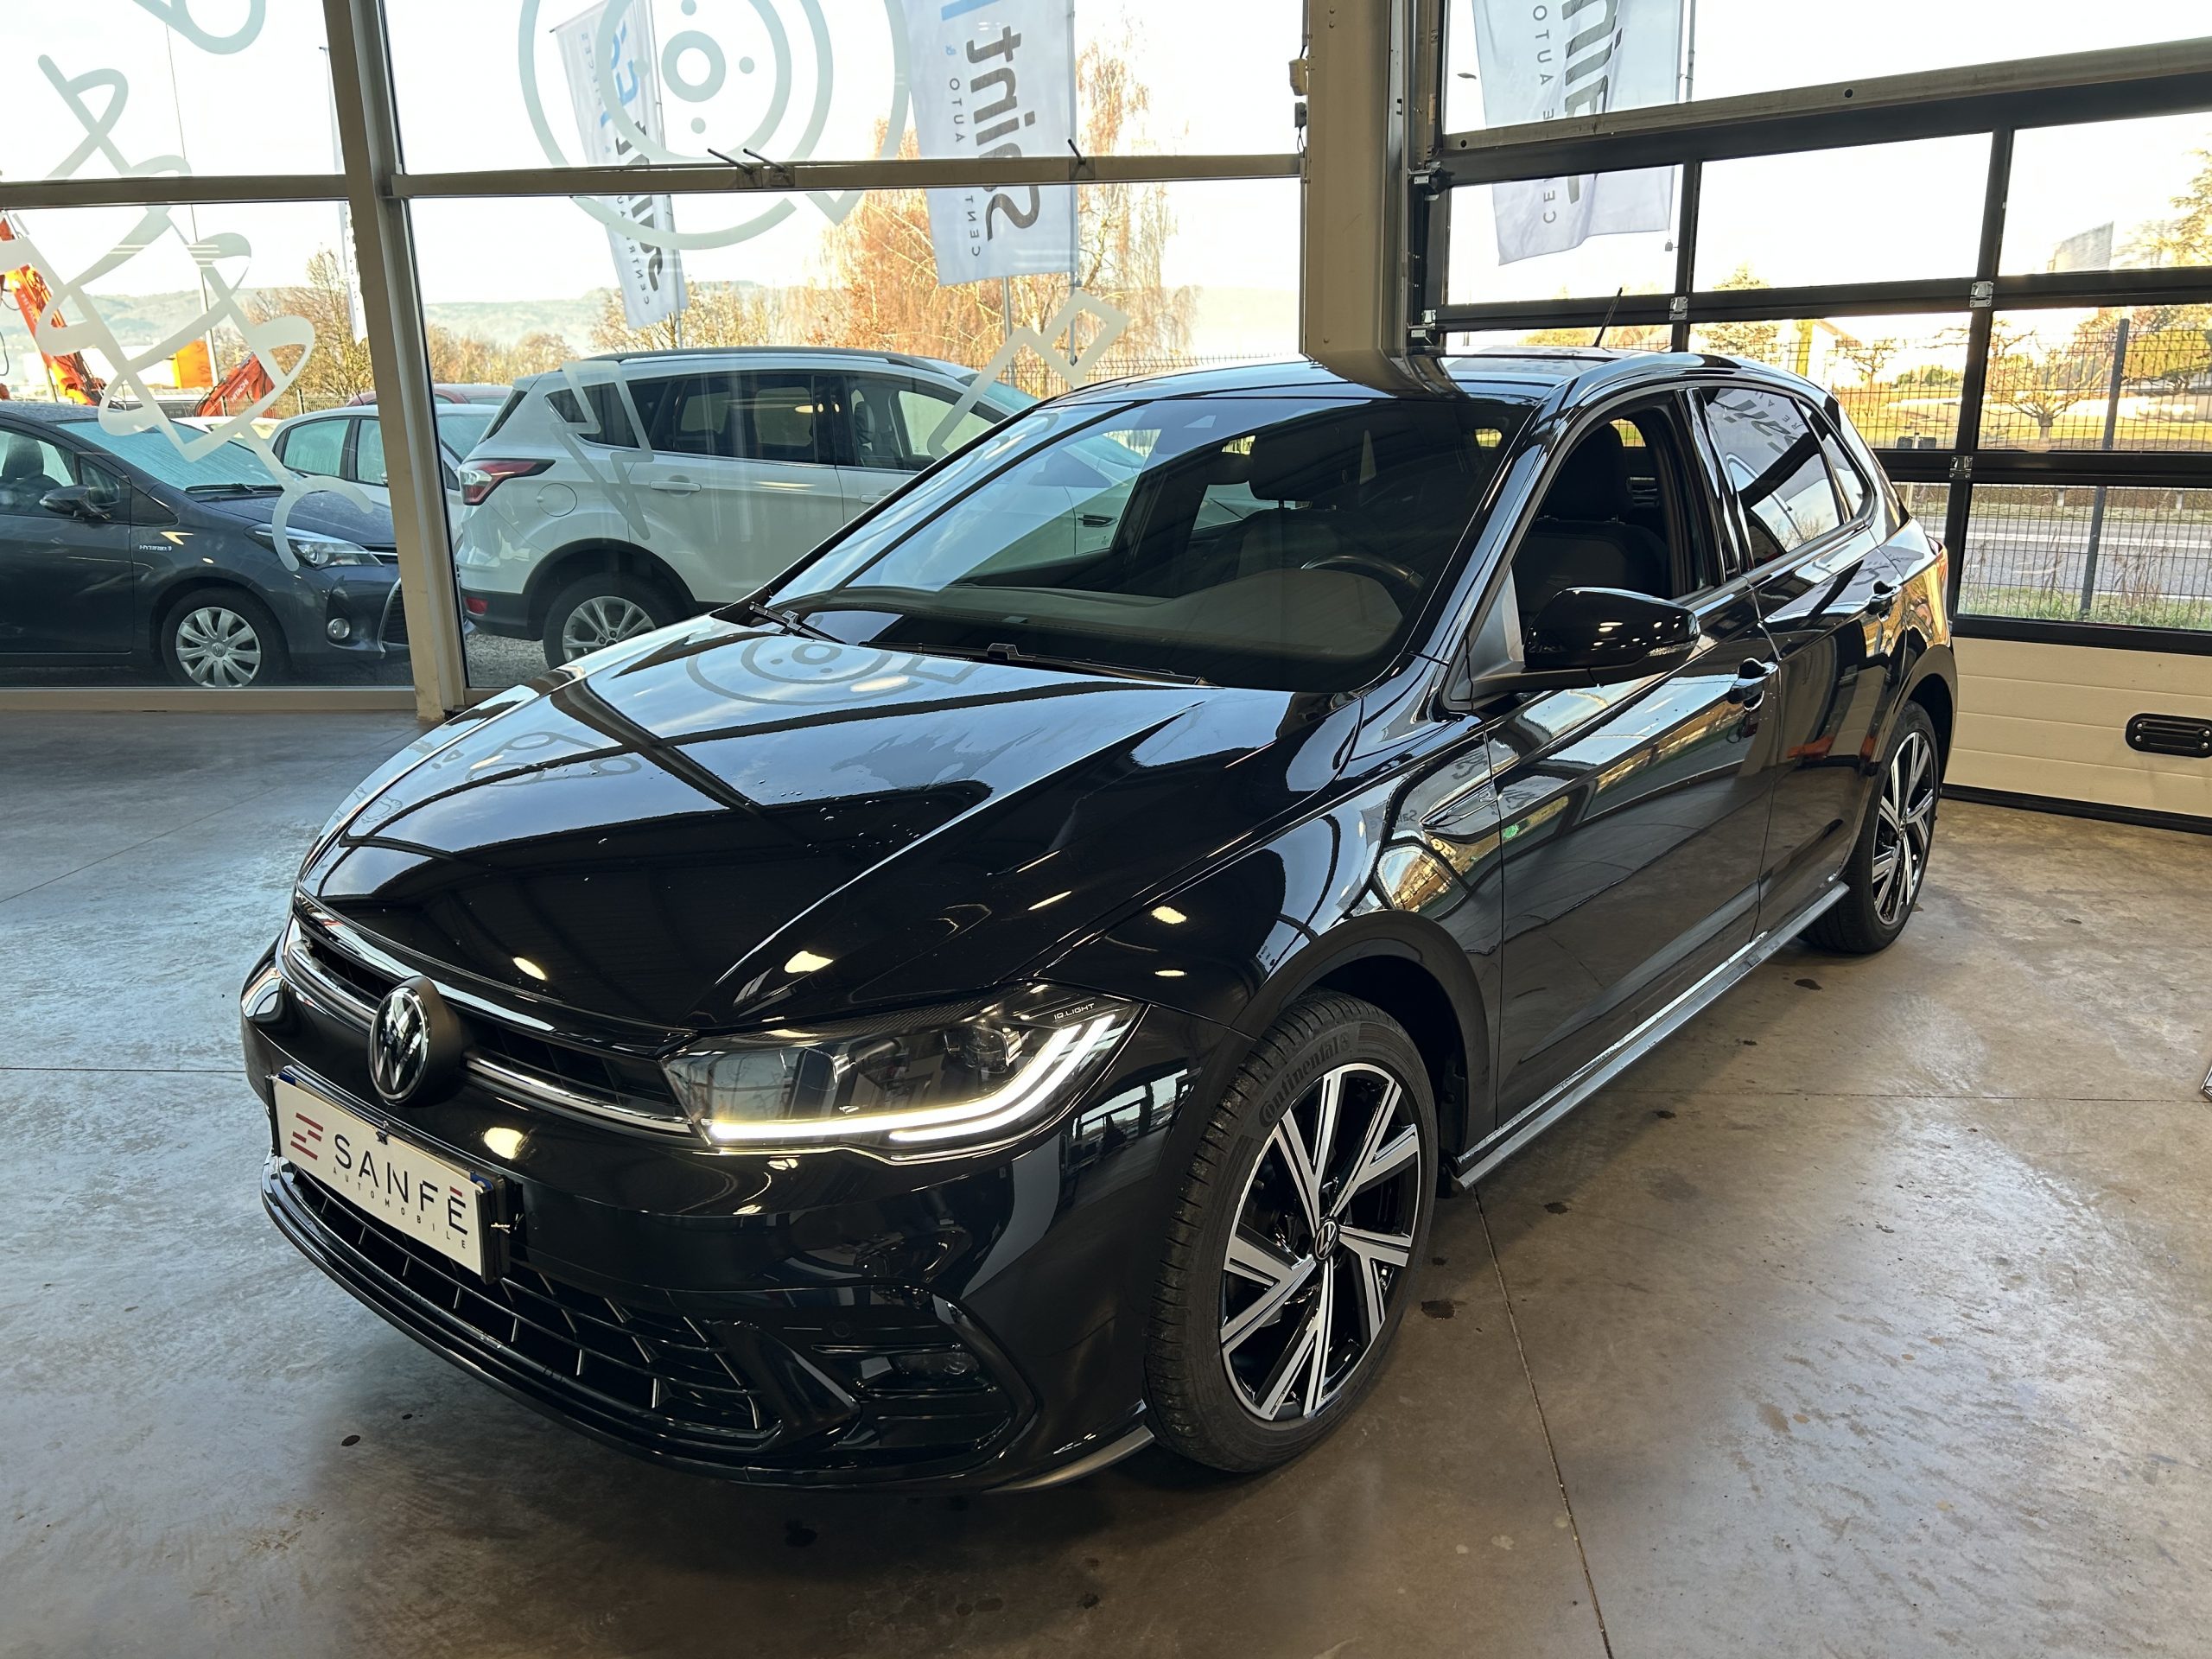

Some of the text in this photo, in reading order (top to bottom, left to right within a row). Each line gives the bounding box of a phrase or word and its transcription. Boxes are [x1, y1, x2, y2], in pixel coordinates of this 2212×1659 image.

[1053, 1002, 1095, 1020] IQ.LIGHT
[1258, 1036, 1339, 1128] Continental
[333, 1166, 467, 1249] AUTOMOBILE
